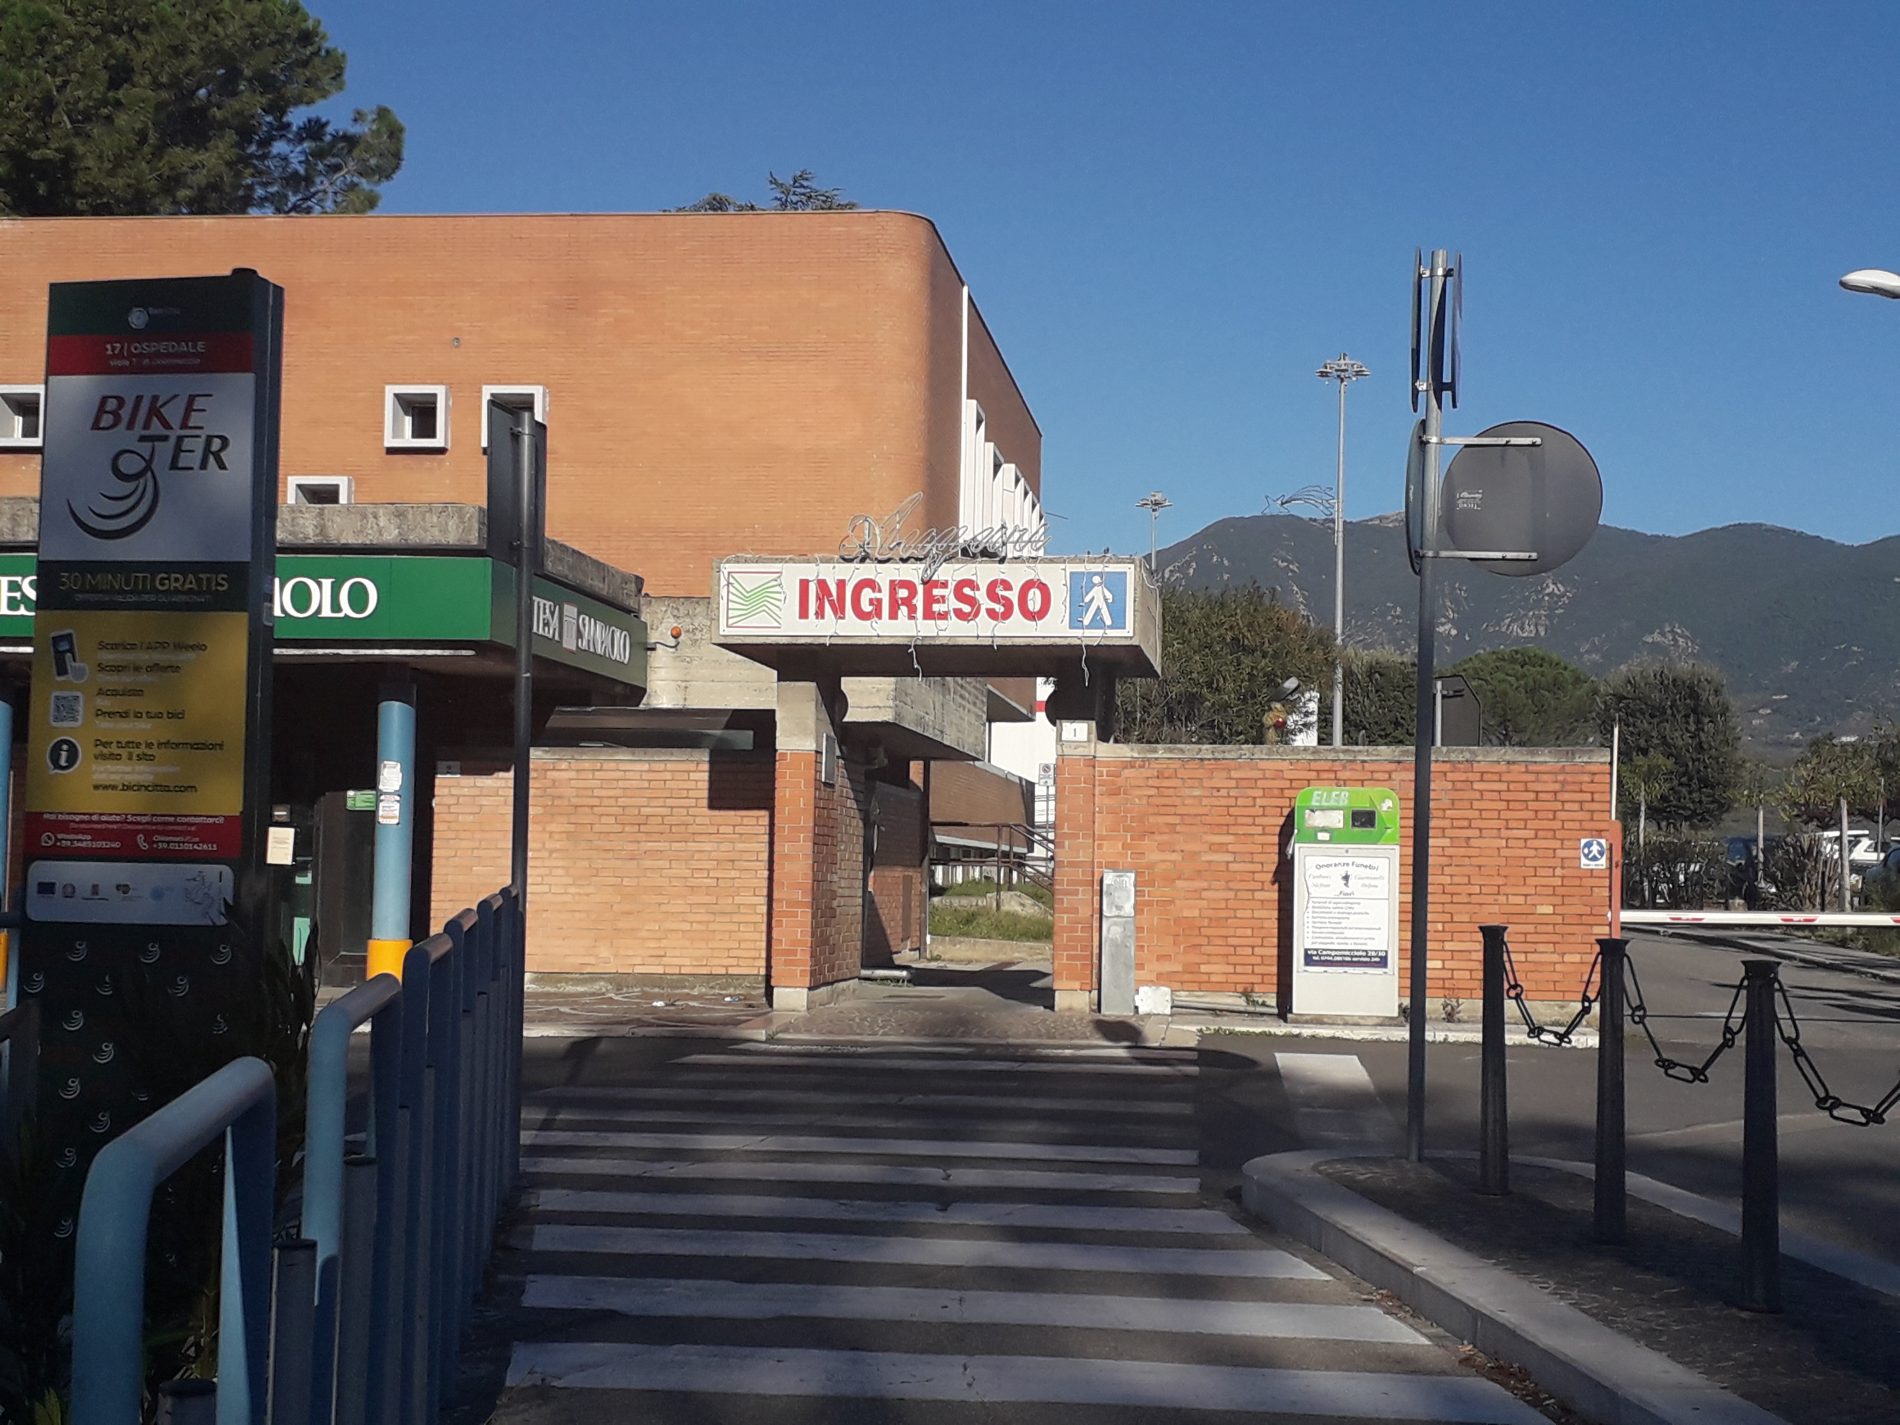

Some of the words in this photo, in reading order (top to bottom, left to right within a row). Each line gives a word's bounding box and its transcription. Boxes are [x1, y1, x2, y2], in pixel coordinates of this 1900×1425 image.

[130, 341, 207, 355] OSPEDALE
[91, 393, 214, 432] BIKE
[58, 572, 82, 591] 30
[86, 573, 151, 591] MINUTI
[155, 573, 230, 592] GRATIS
[797, 578, 1052, 622] INGRESSO
[578, 614, 631, 665] SANPAOLO
[95, 708, 131, 720] Prendi
[94, 738, 114, 750] Per
[117, 739, 143, 750] tutte
[144, 739, 155, 750] le
[157, 740, 225, 752] informazioni
[136, 751, 157, 762] sito
